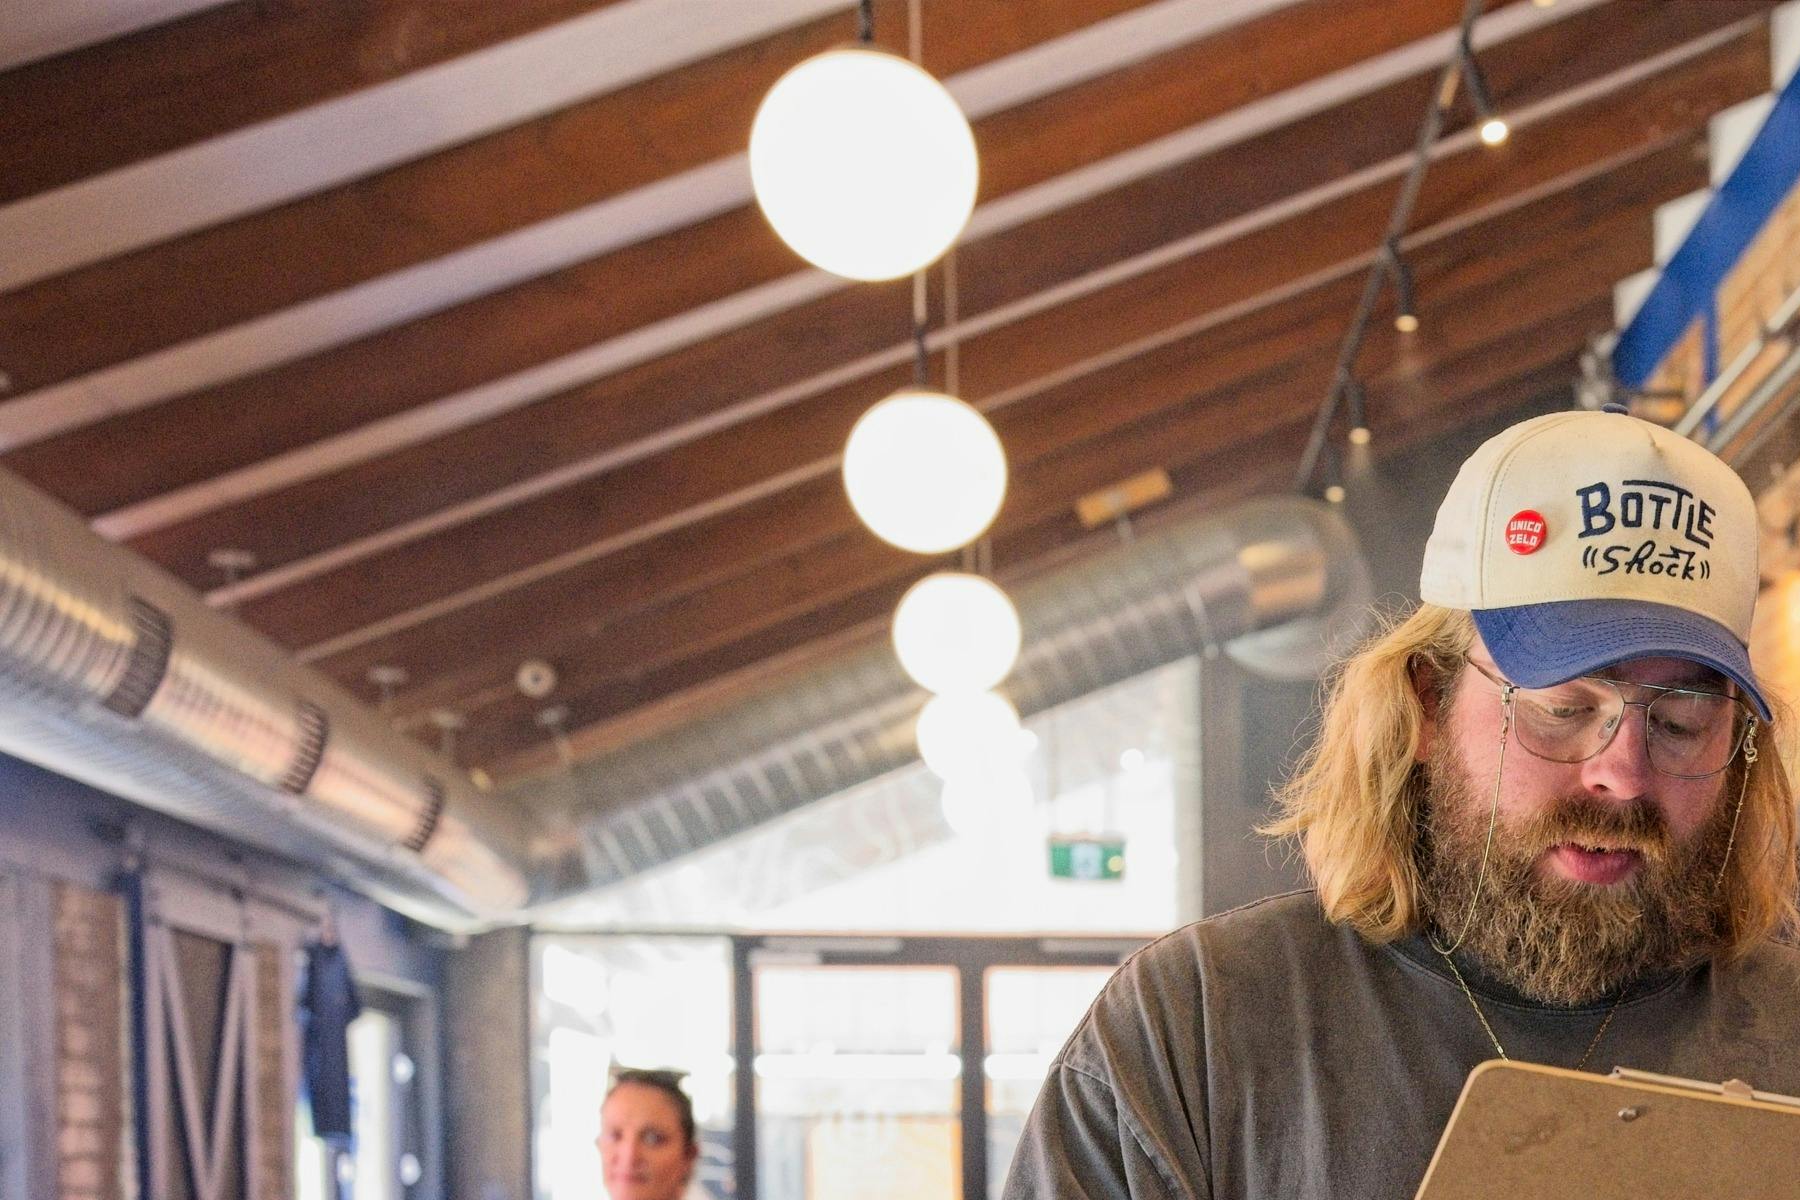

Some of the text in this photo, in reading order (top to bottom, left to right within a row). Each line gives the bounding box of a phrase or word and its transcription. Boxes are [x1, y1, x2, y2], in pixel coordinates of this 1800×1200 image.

[1575, 479, 1716, 550] BOTTLE
[1509, 520, 1542, 533] UNICO
[1509, 533, 1538, 546] ZELO
